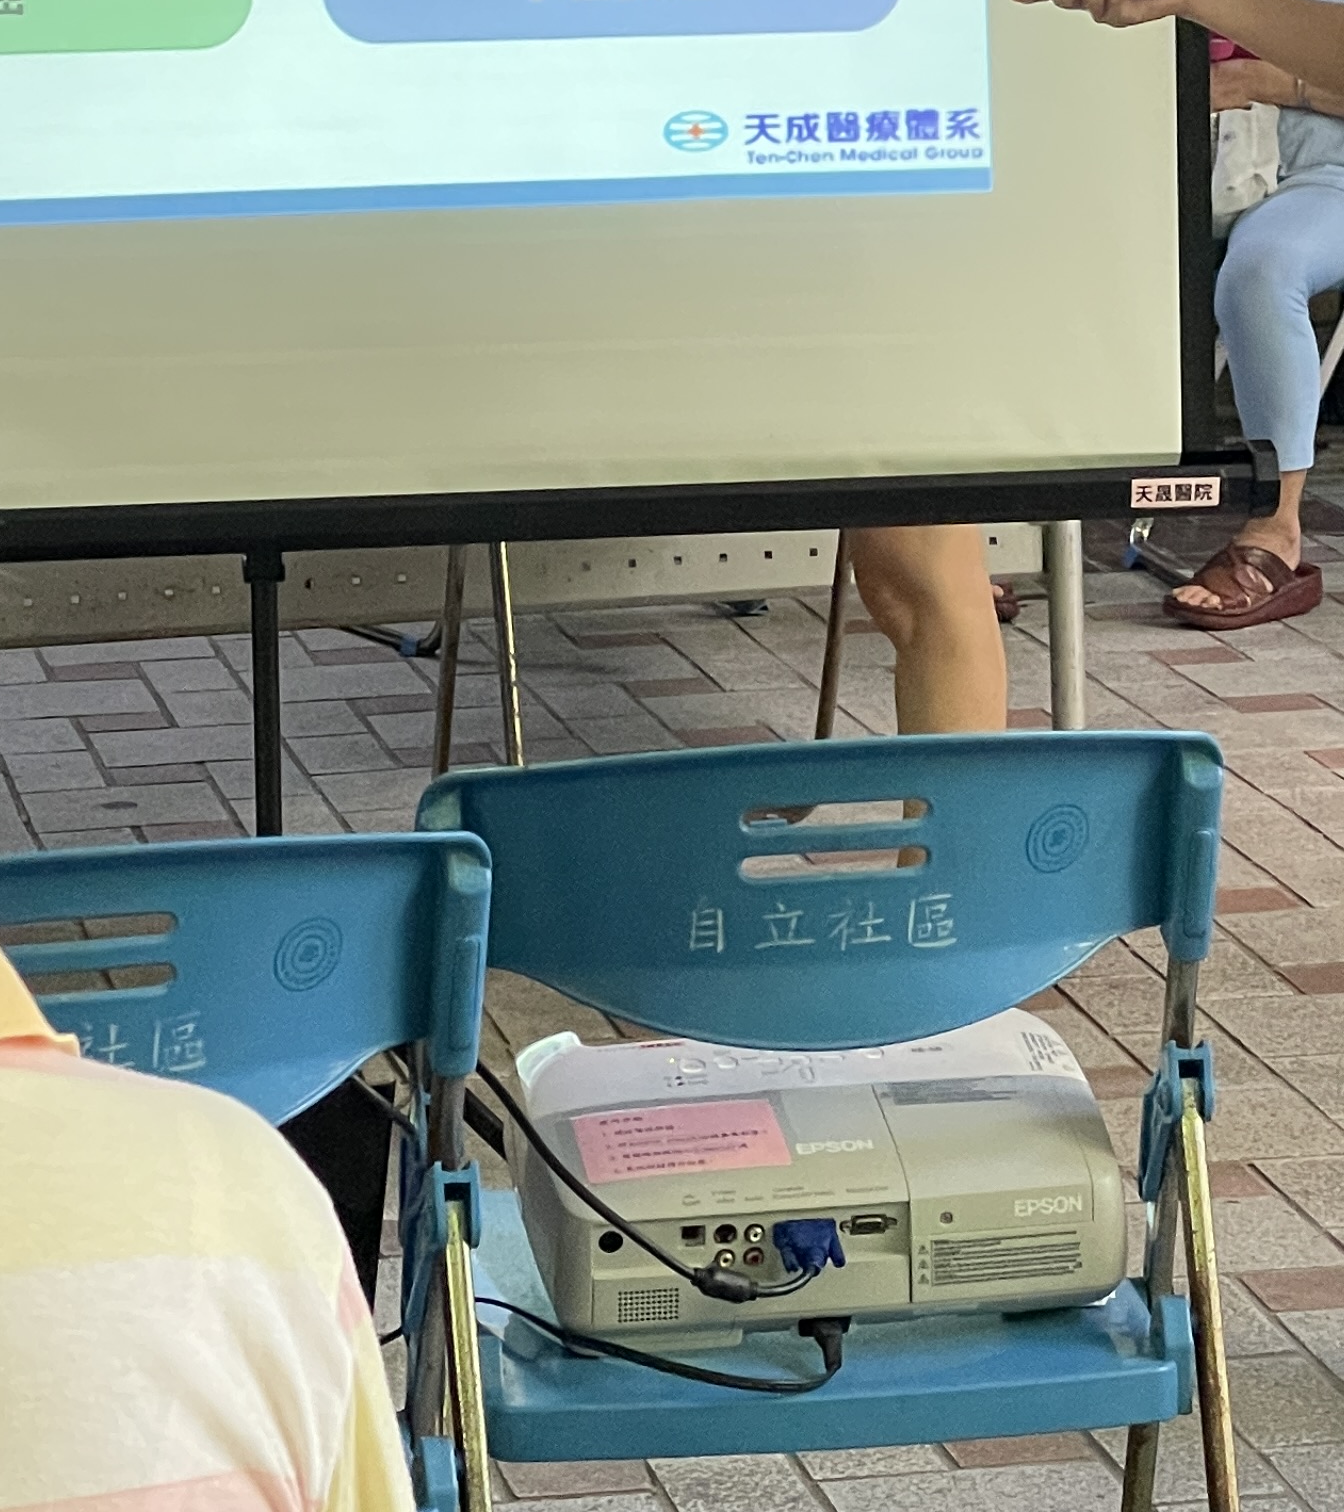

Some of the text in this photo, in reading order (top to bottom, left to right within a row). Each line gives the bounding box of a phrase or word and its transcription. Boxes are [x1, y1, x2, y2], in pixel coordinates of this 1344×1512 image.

[744, 107, 981, 145] 天成醫療體系
[746, 145, 984, 165] Ten-Chen Medical Group
[1135, 484, 1213, 503] 天晟醫院
[689, 893, 957, 954] 自立社區
[796, 1139, 874, 1155] EPSON
[1014, 1193, 1083, 1217] EPSON
